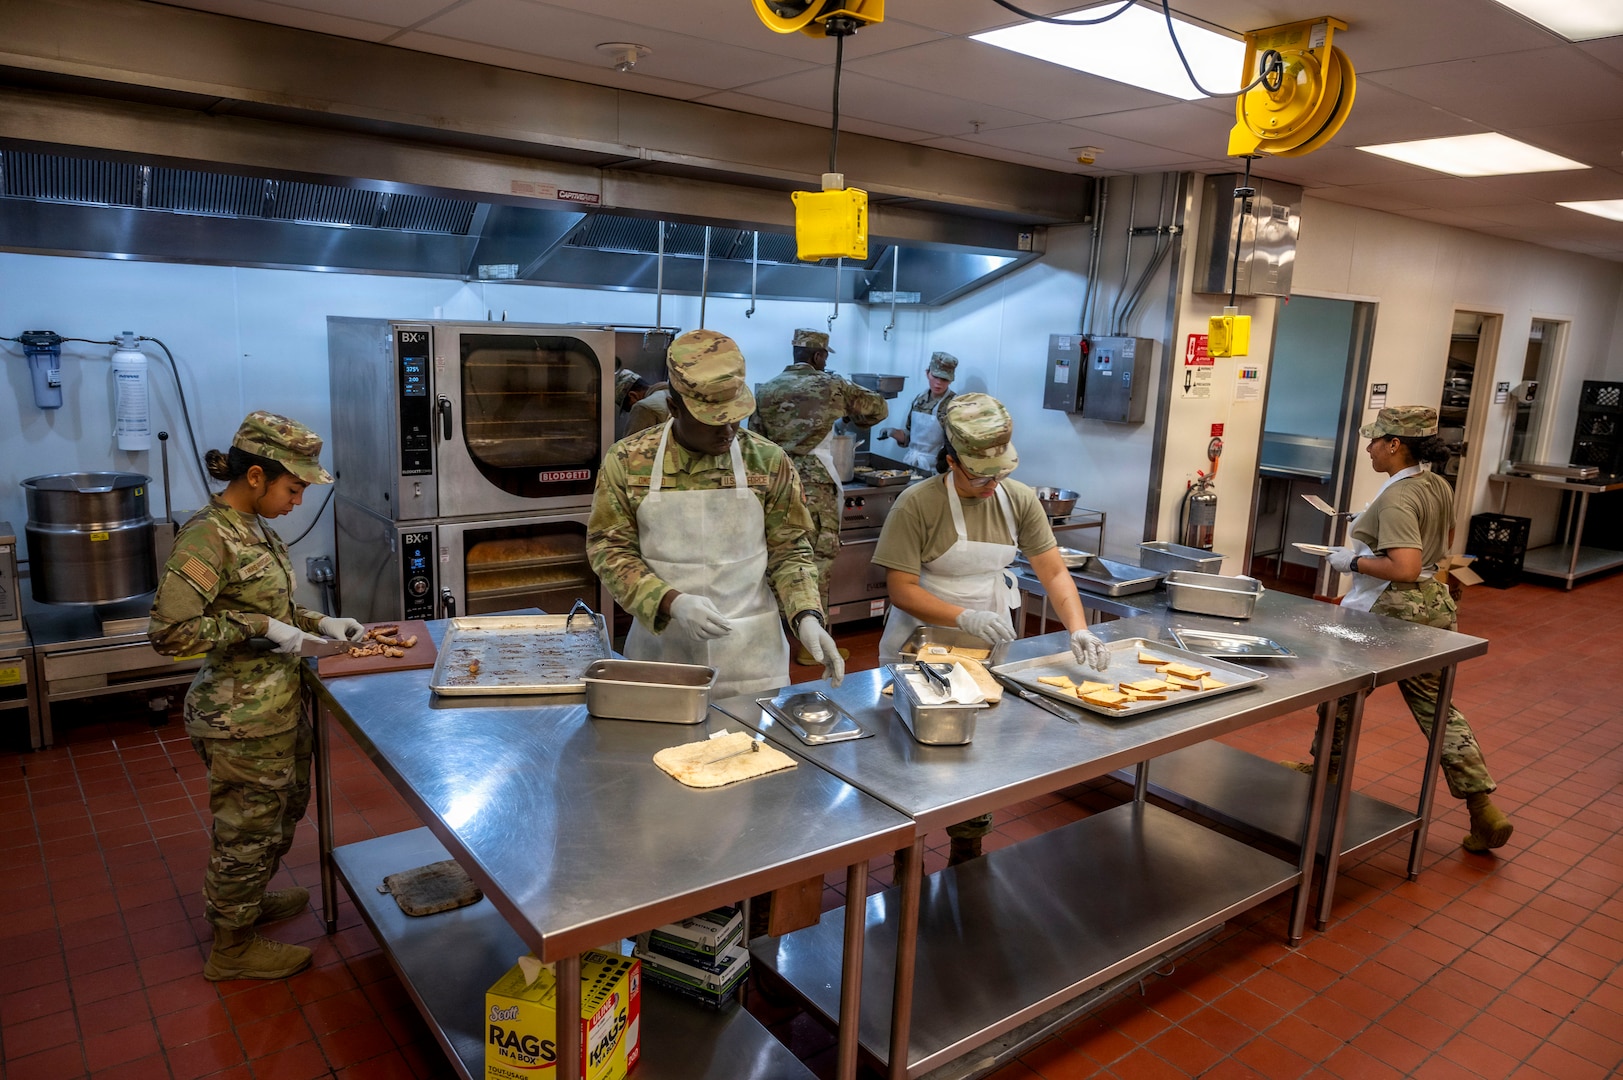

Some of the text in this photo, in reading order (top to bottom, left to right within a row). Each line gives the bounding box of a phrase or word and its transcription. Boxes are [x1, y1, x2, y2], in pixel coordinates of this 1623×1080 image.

[542, 471, 588, 481] BLODGETT
[489, 1005, 519, 1022] Scott
[489, 1024, 557, 1062] RAGS
[499, 1048, 536, 1065] IN A BOX
[488, 1066, 529, 1080] TOUT-USAGE
